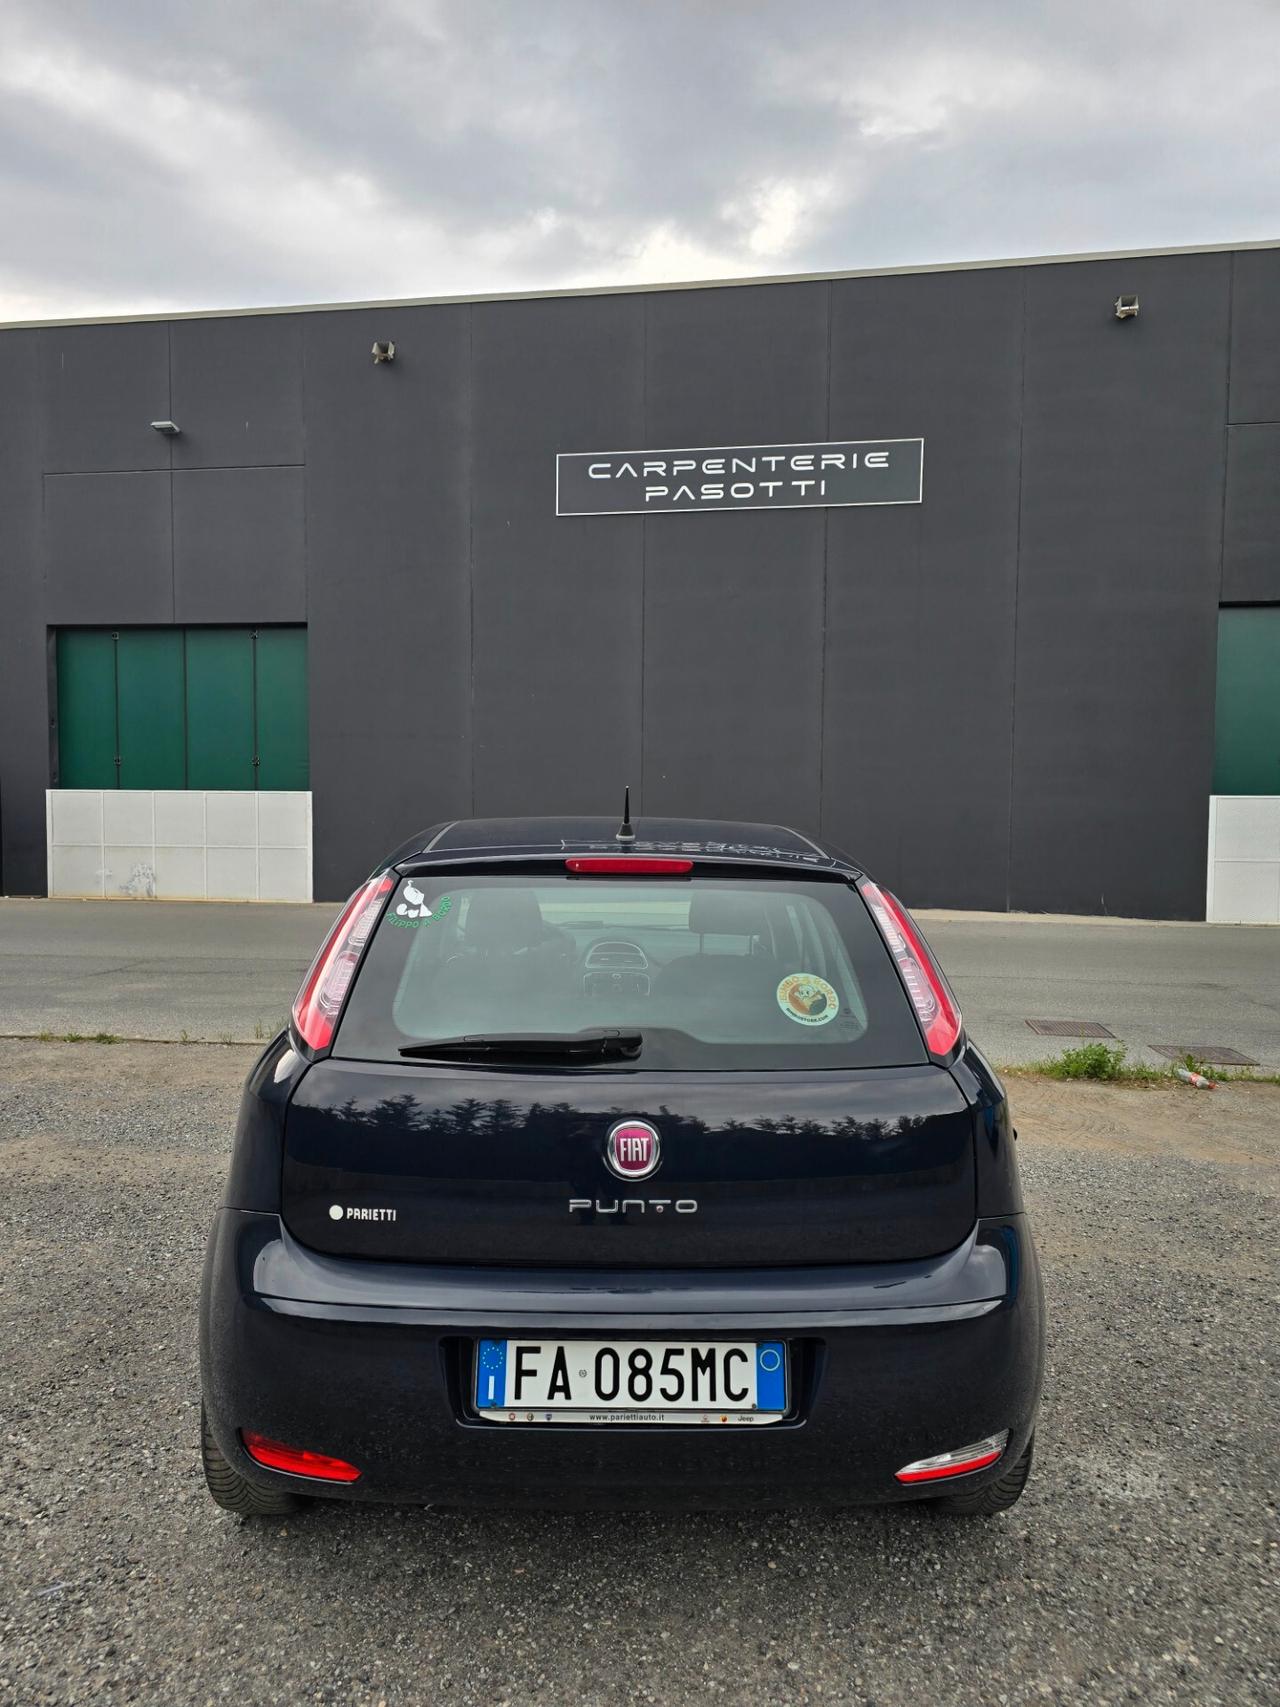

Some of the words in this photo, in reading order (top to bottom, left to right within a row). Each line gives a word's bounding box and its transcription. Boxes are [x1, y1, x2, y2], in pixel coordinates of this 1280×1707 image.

[588, 452, 889, 479] CARPENTERIE
[645, 480, 826, 502] PASOTTI
[432, 896, 452, 920] BORDO
[620, 1138, 649, 1161] FIAT
[346, 1207, 397, 1221] PARIETTI
[569, 1199, 698, 1213] PUNTO
[514, 1346, 572, 1400] FA
[594, 1347, 749, 1402] 085MC
[487, 1375, 495, 1400] I
[589, 1412, 665, 1422] www.pariettiauto.it
